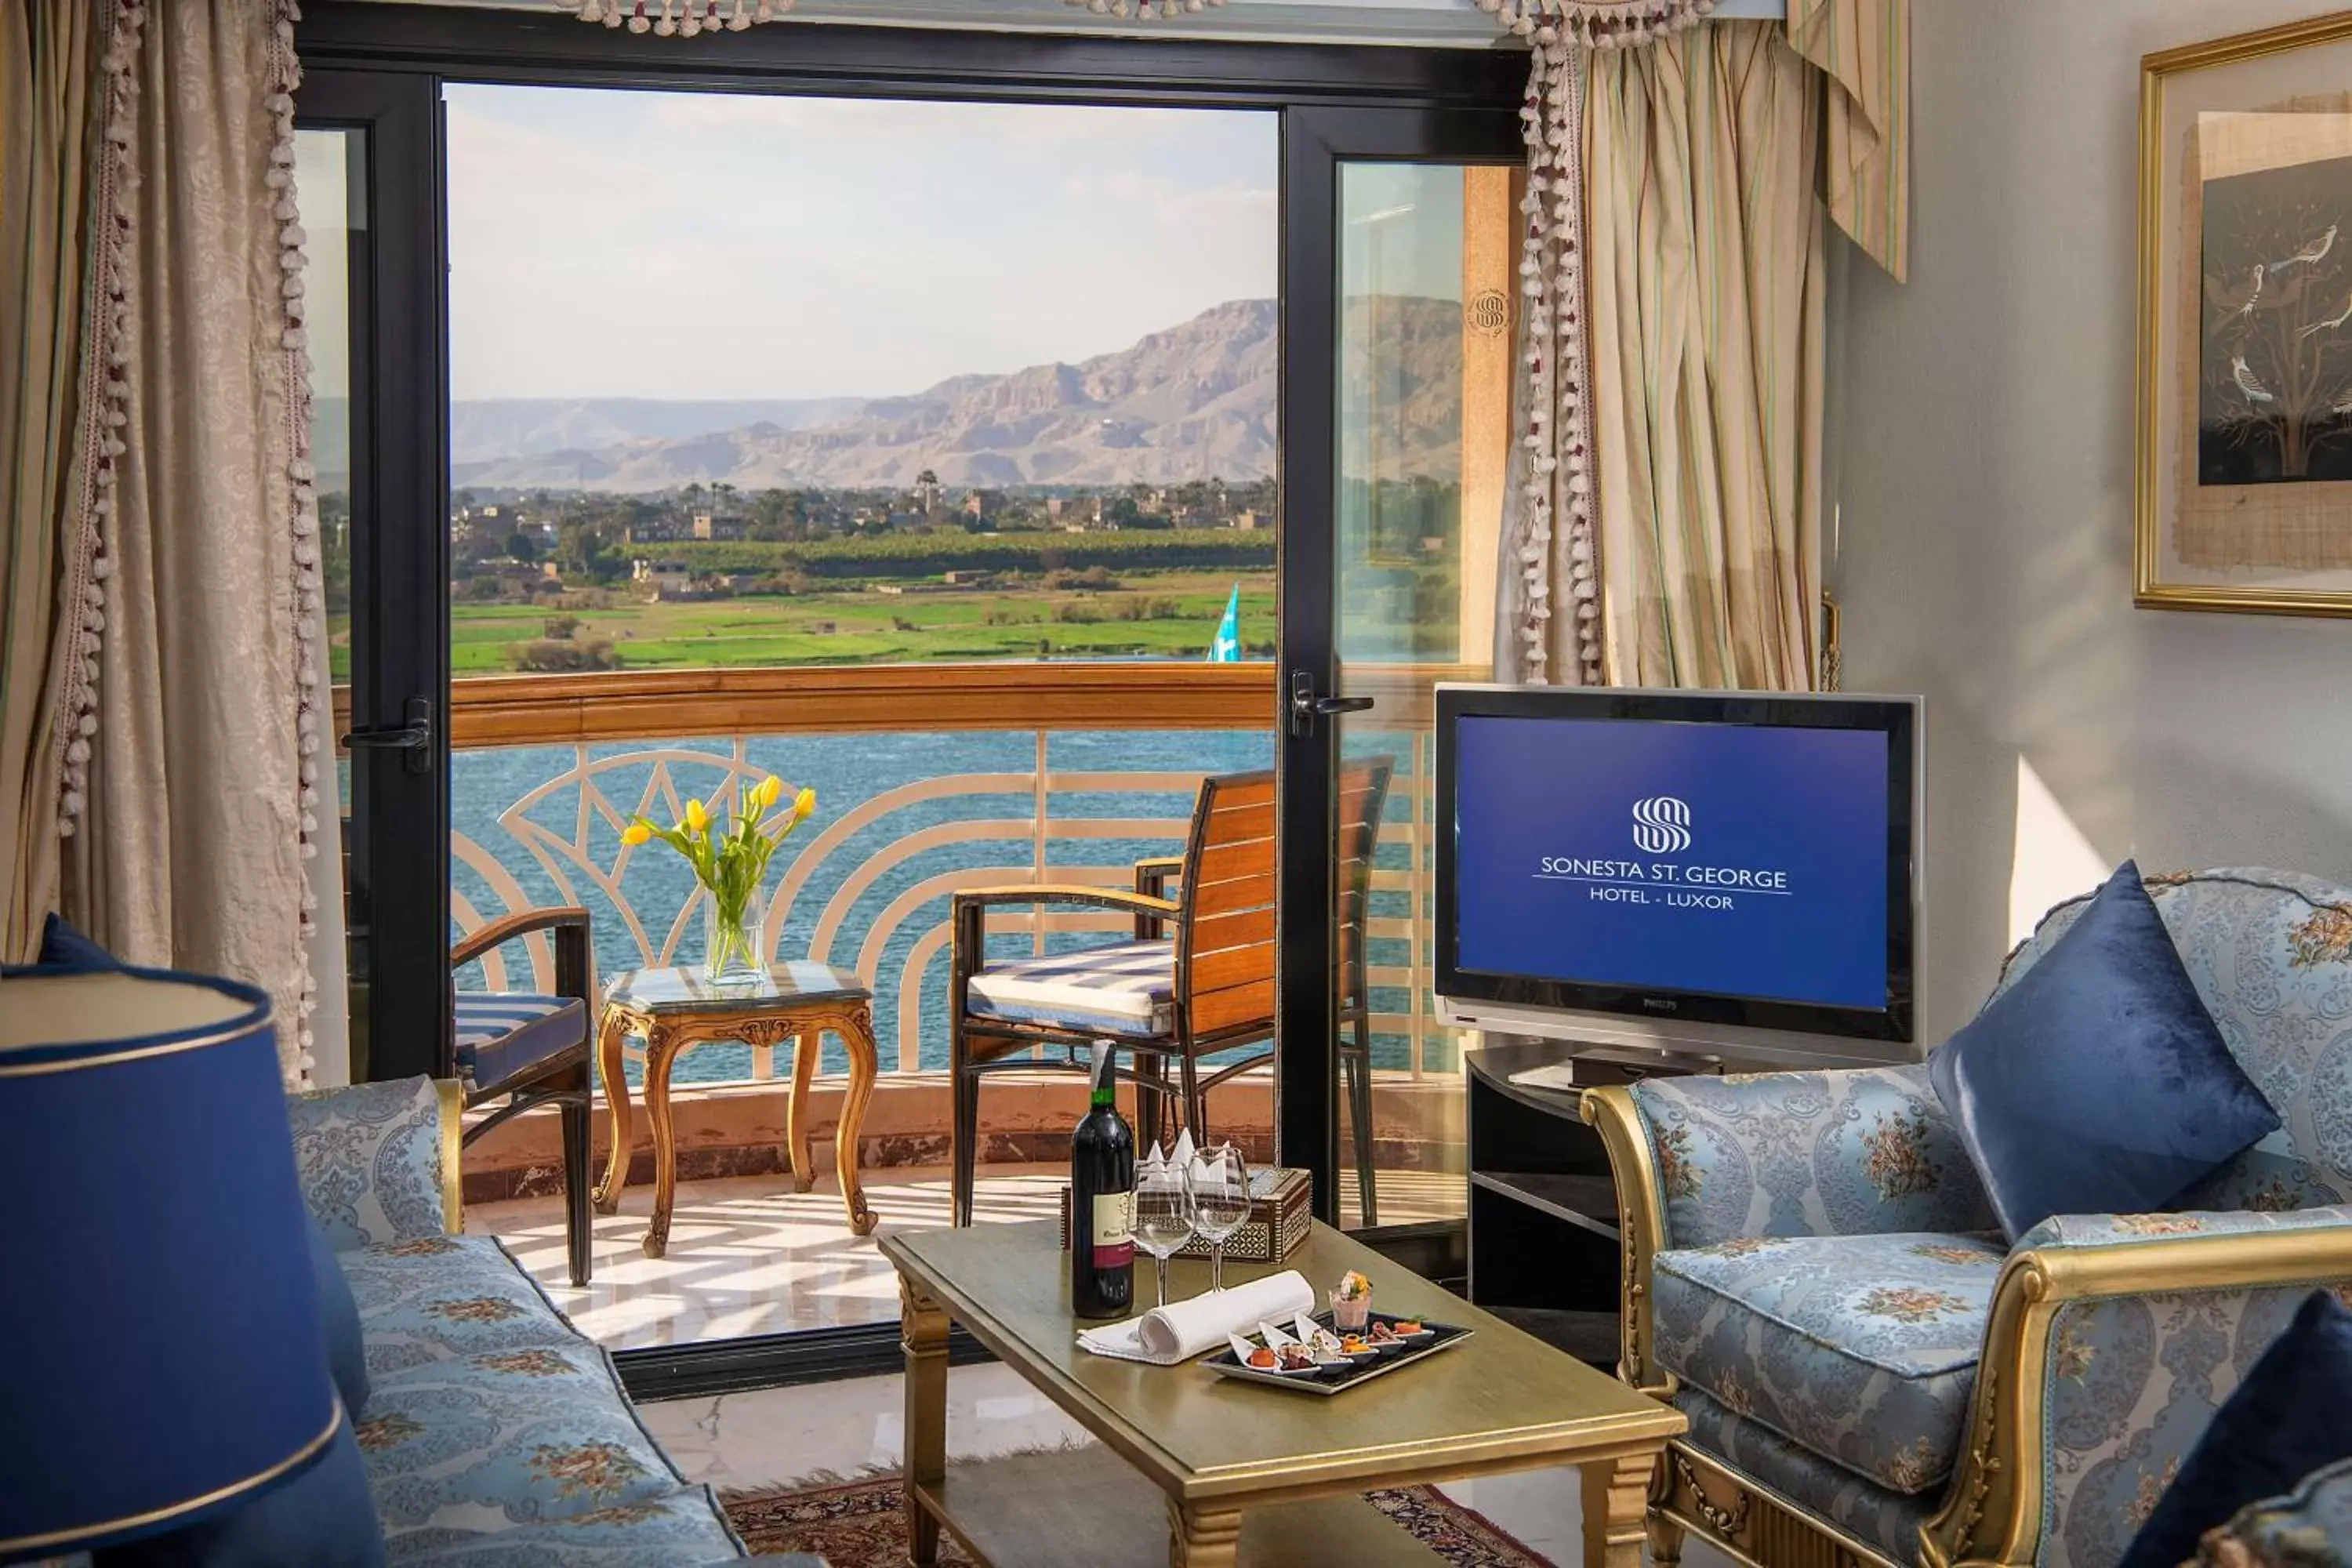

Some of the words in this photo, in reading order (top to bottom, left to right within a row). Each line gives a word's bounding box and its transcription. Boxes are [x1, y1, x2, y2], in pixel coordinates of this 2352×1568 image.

[1541, 856, 1644, 879] SONESTA
[1651, 864, 1680, 881] ST.
[1685, 866, 1787, 888] GEORGE
[1590, 887, 1650, 904] HOTEL
[1668, 892, 1734, 909] LUXOR
